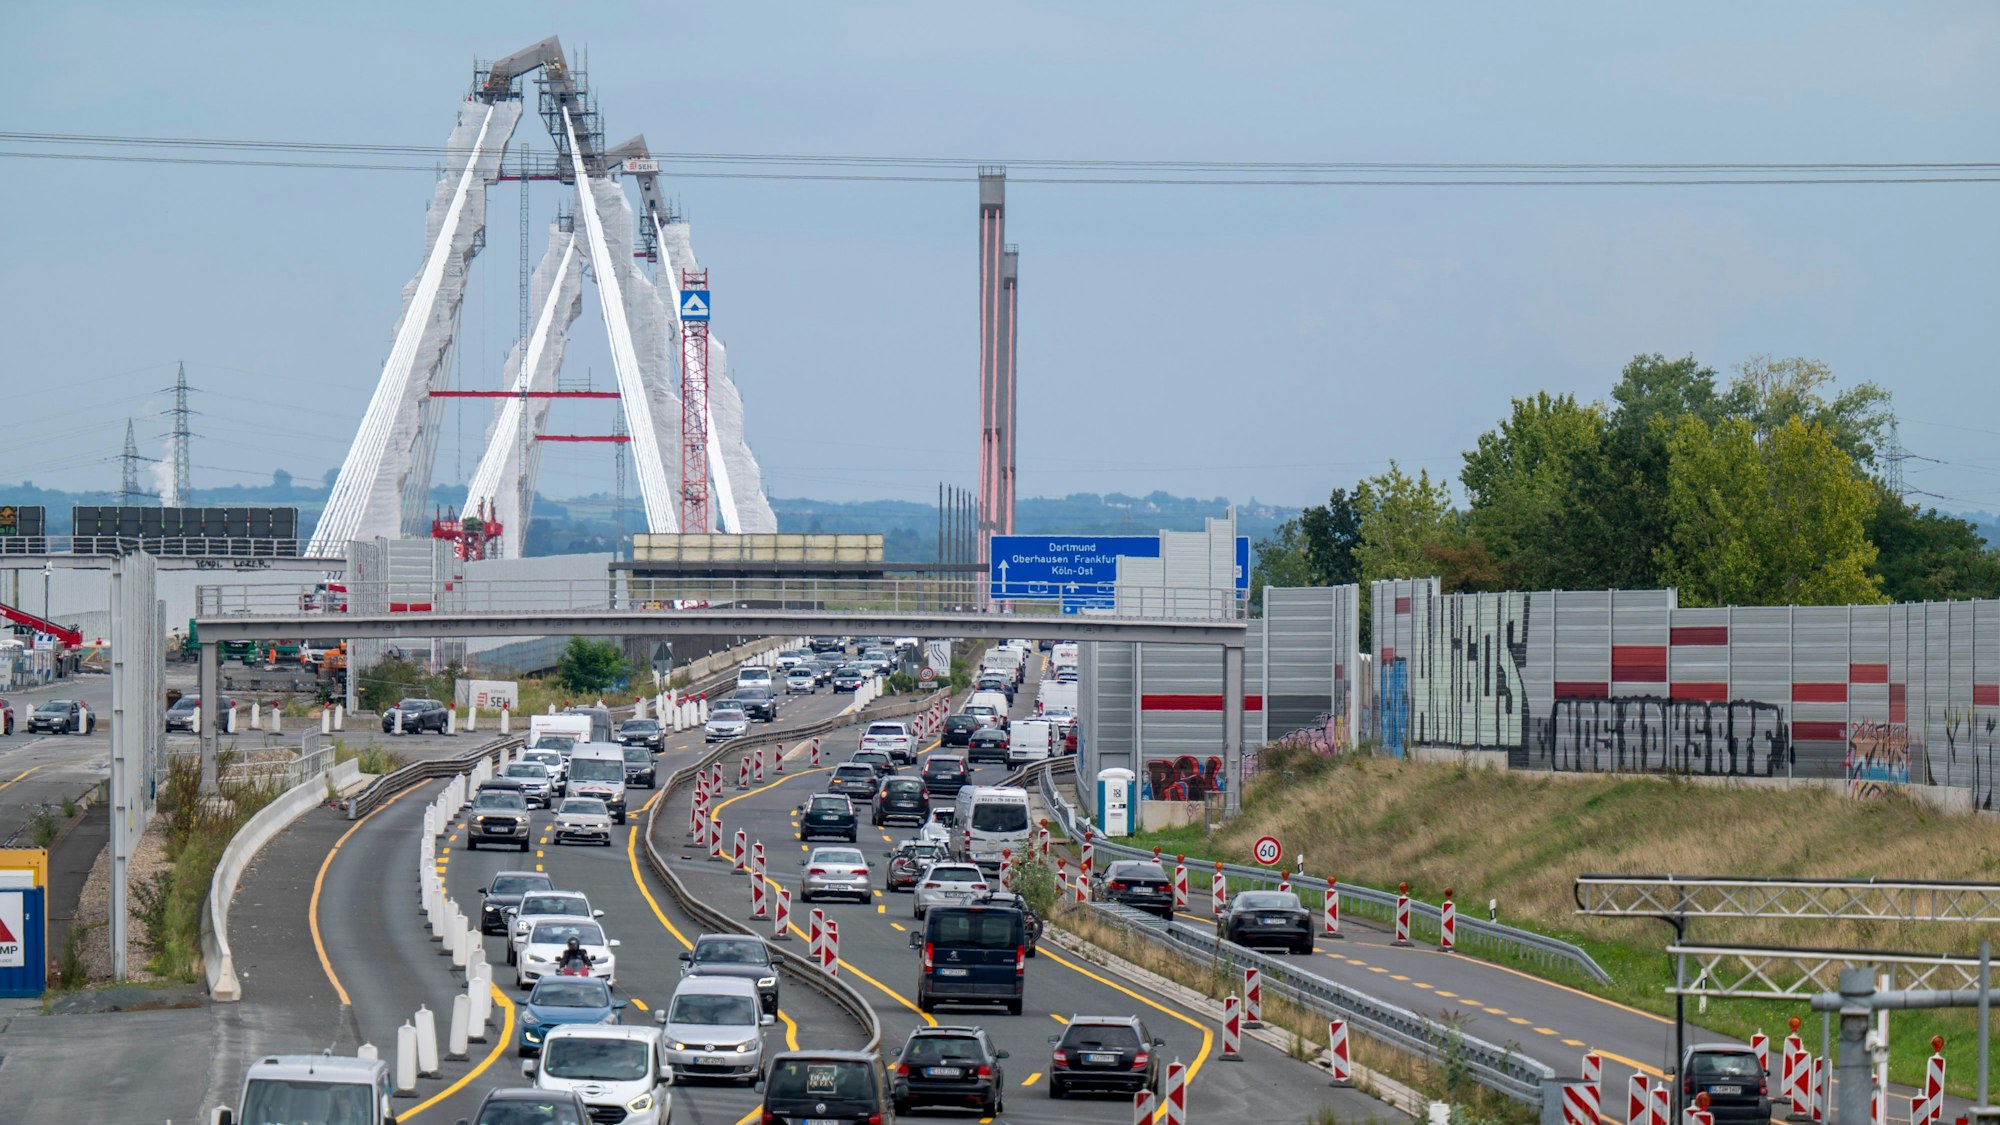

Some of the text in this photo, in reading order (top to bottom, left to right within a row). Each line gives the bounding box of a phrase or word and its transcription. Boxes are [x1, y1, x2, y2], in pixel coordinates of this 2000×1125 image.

[1049, 543, 1096, 552] Dortmund
[1012, 555, 1117, 564] Oberhausen Frankfur
[1051, 566, 1093, 576] Köln-Ost
[1260, 844, 1276, 858] 60
